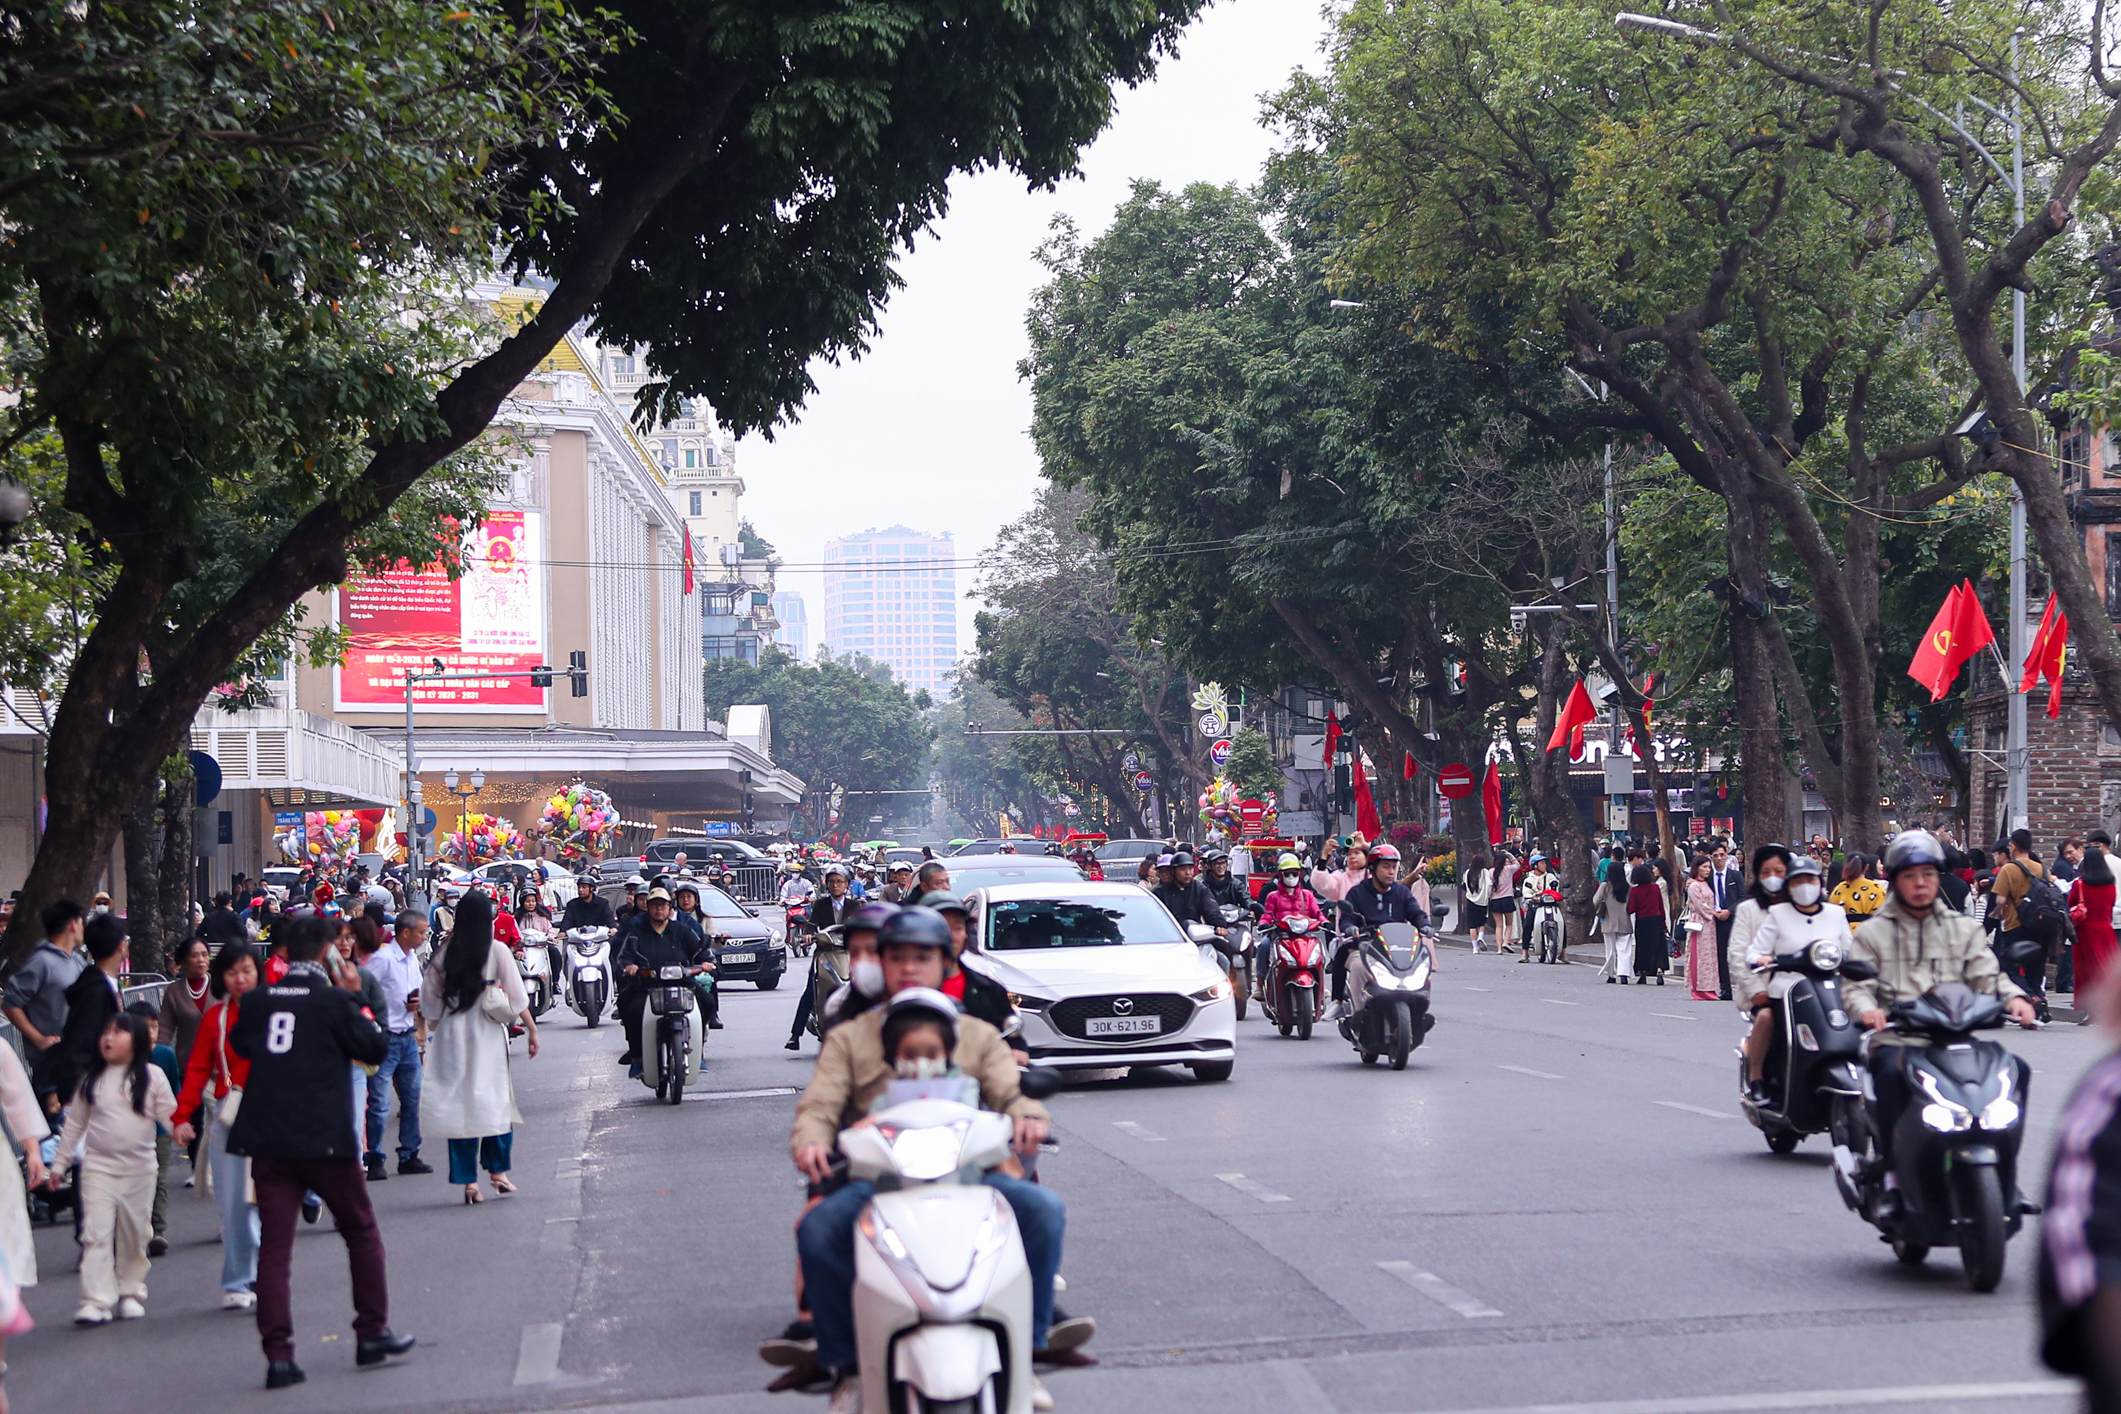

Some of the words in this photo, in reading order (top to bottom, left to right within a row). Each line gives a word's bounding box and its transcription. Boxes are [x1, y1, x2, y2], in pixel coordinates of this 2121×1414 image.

[437, 691, 456, 699] 2026
[461, 691, 479, 700] 2031
[1093, 1020, 1154, 1032] 30K-621.96
[267, 1011, 296, 1054] 8
